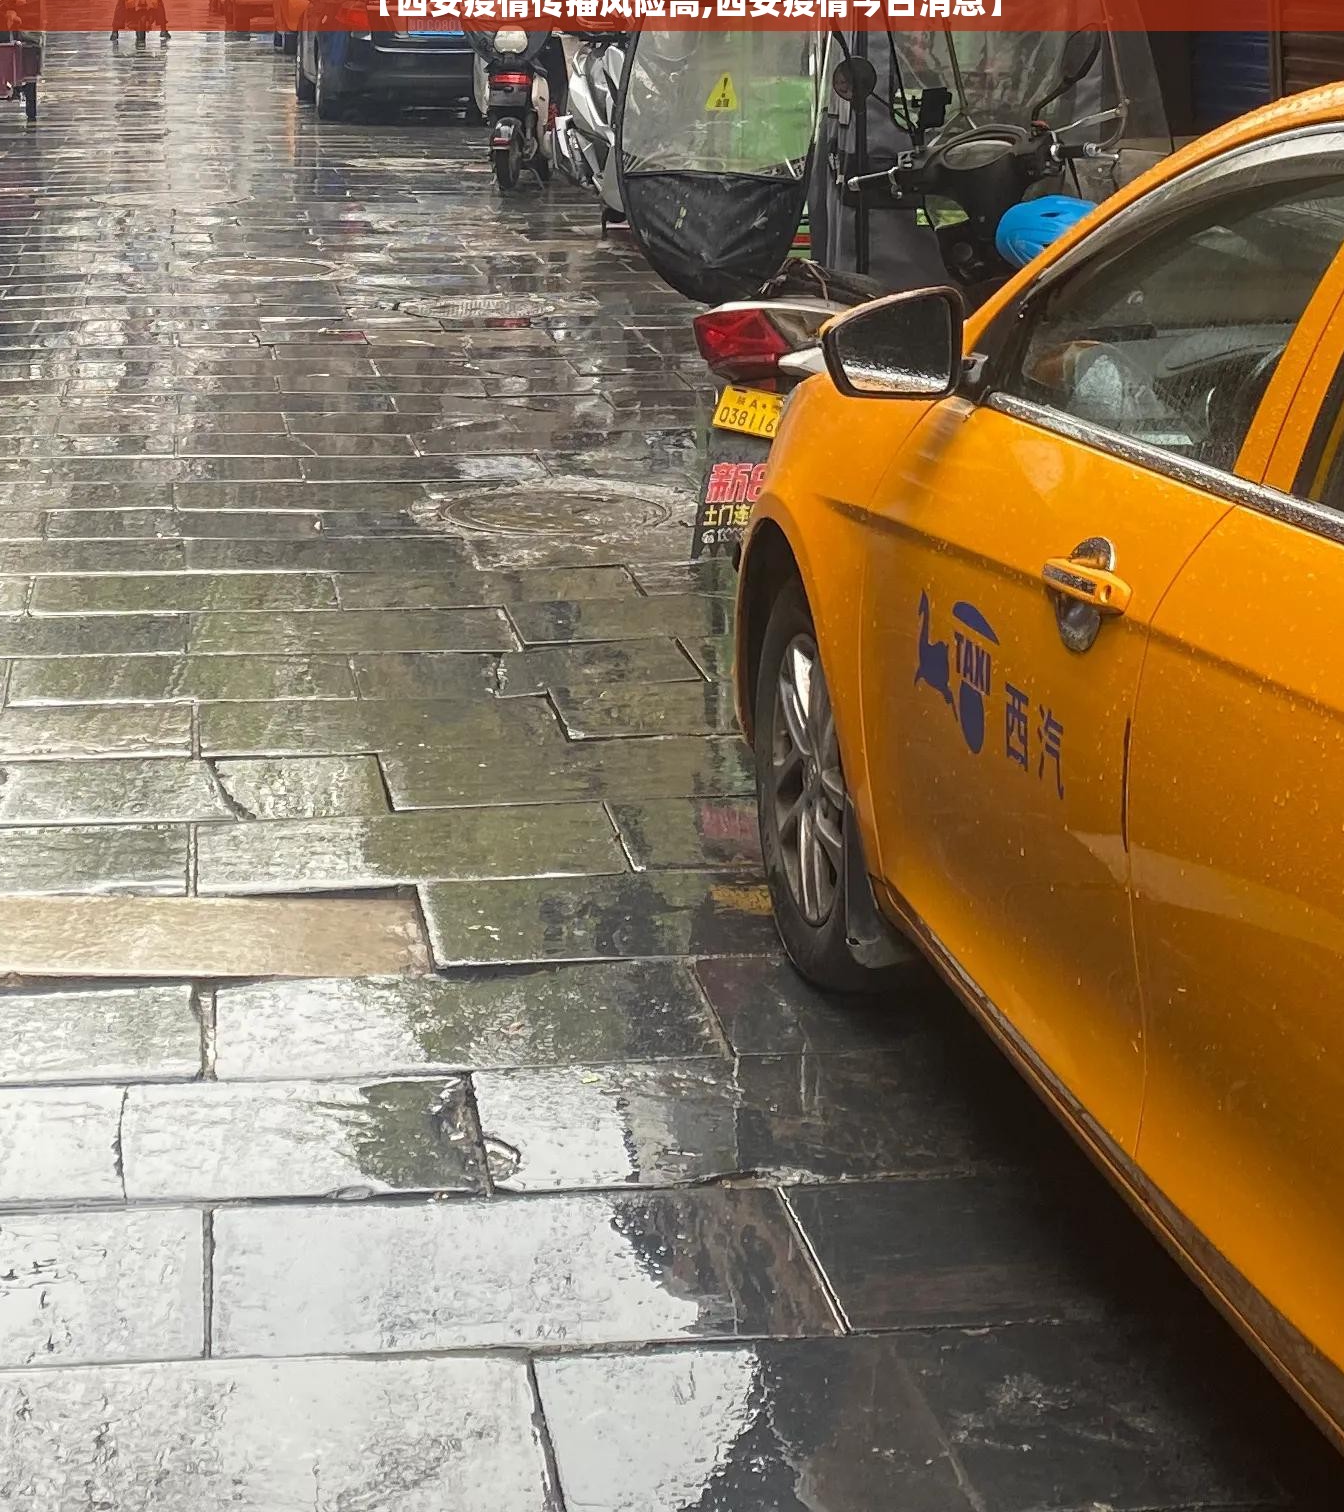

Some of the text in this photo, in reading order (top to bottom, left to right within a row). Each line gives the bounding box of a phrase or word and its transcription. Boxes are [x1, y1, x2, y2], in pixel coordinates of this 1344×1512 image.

[719, 406, 778, 433] 038116
[703, 504, 754, 527] 土门连
[954, 632, 992, 696] TAXI
[1005, 682, 1064, 800] 西汽
